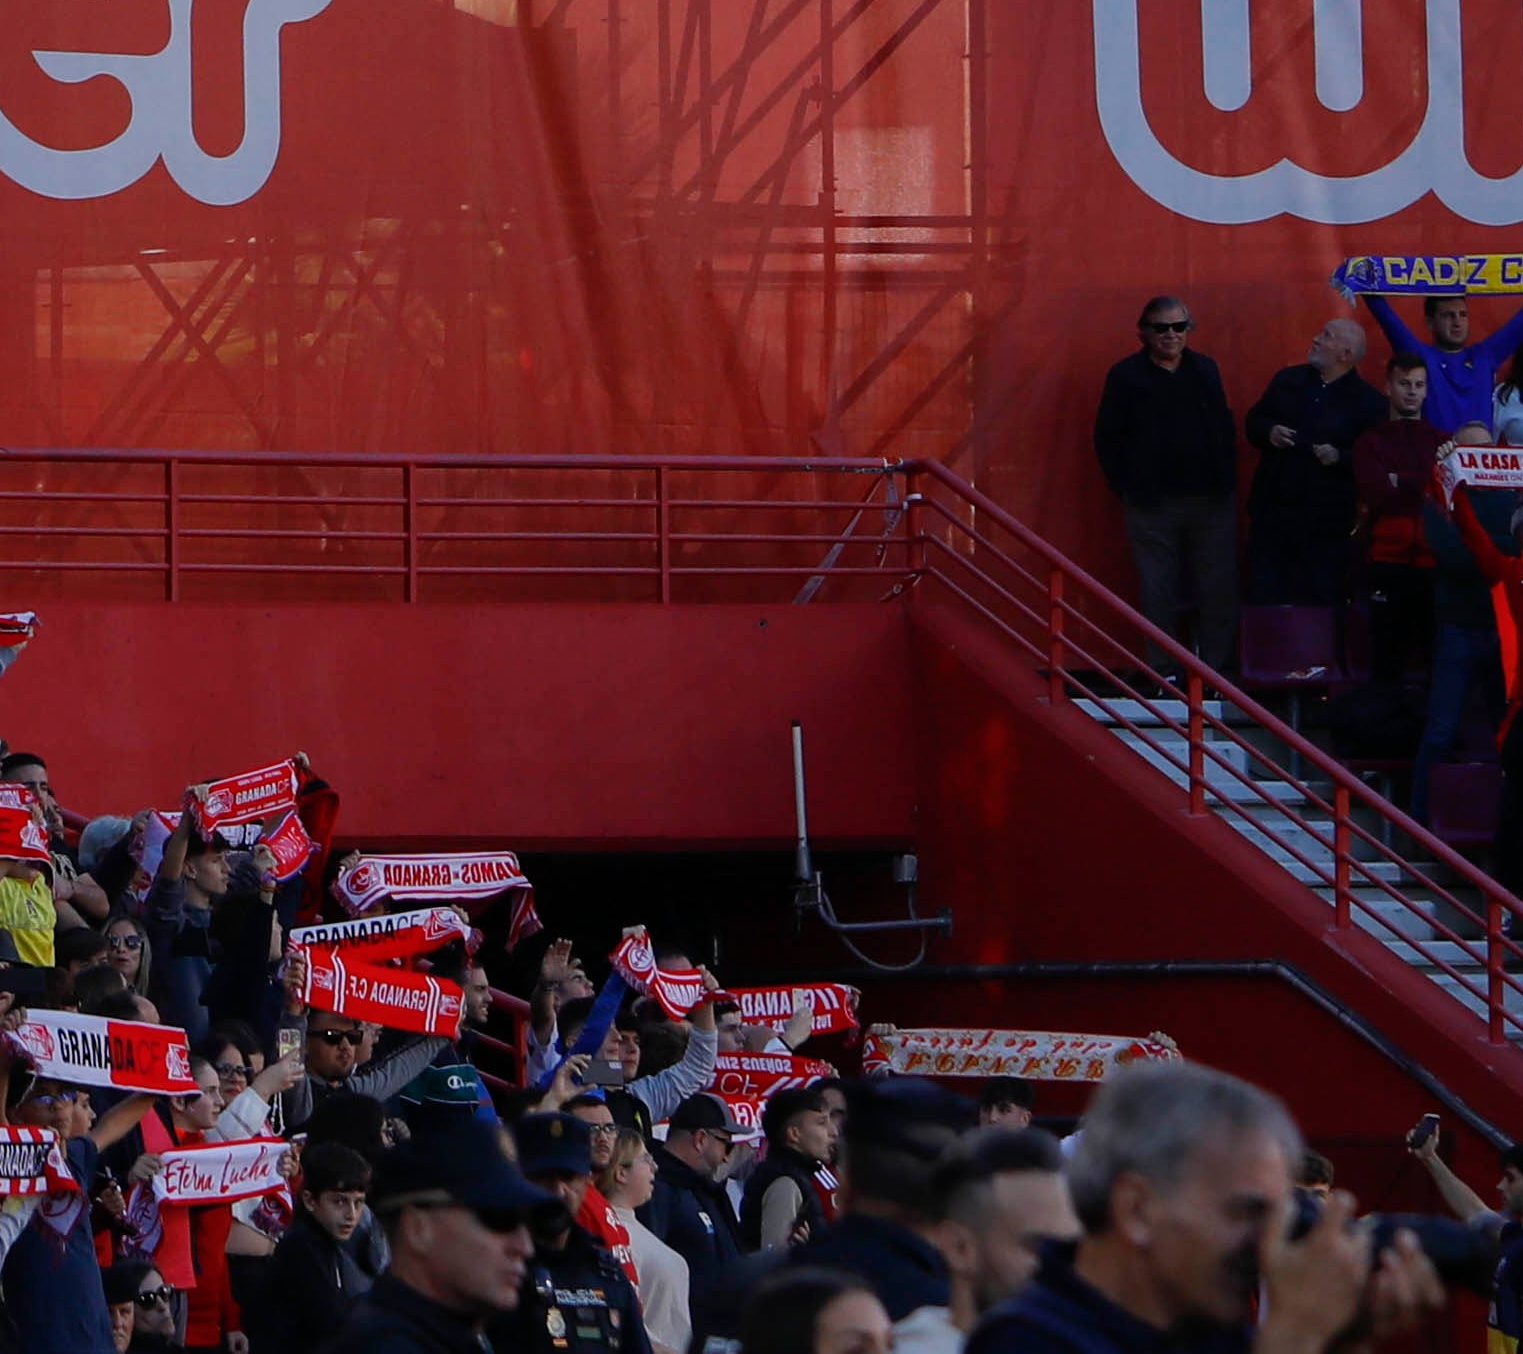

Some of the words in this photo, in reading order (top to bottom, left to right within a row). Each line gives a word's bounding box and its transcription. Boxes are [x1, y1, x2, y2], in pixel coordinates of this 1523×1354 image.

[1384, 259, 1488, 287] CADIZ
[1460, 452, 1476, 470] LA
[1481, 452, 1518, 471] CASA
